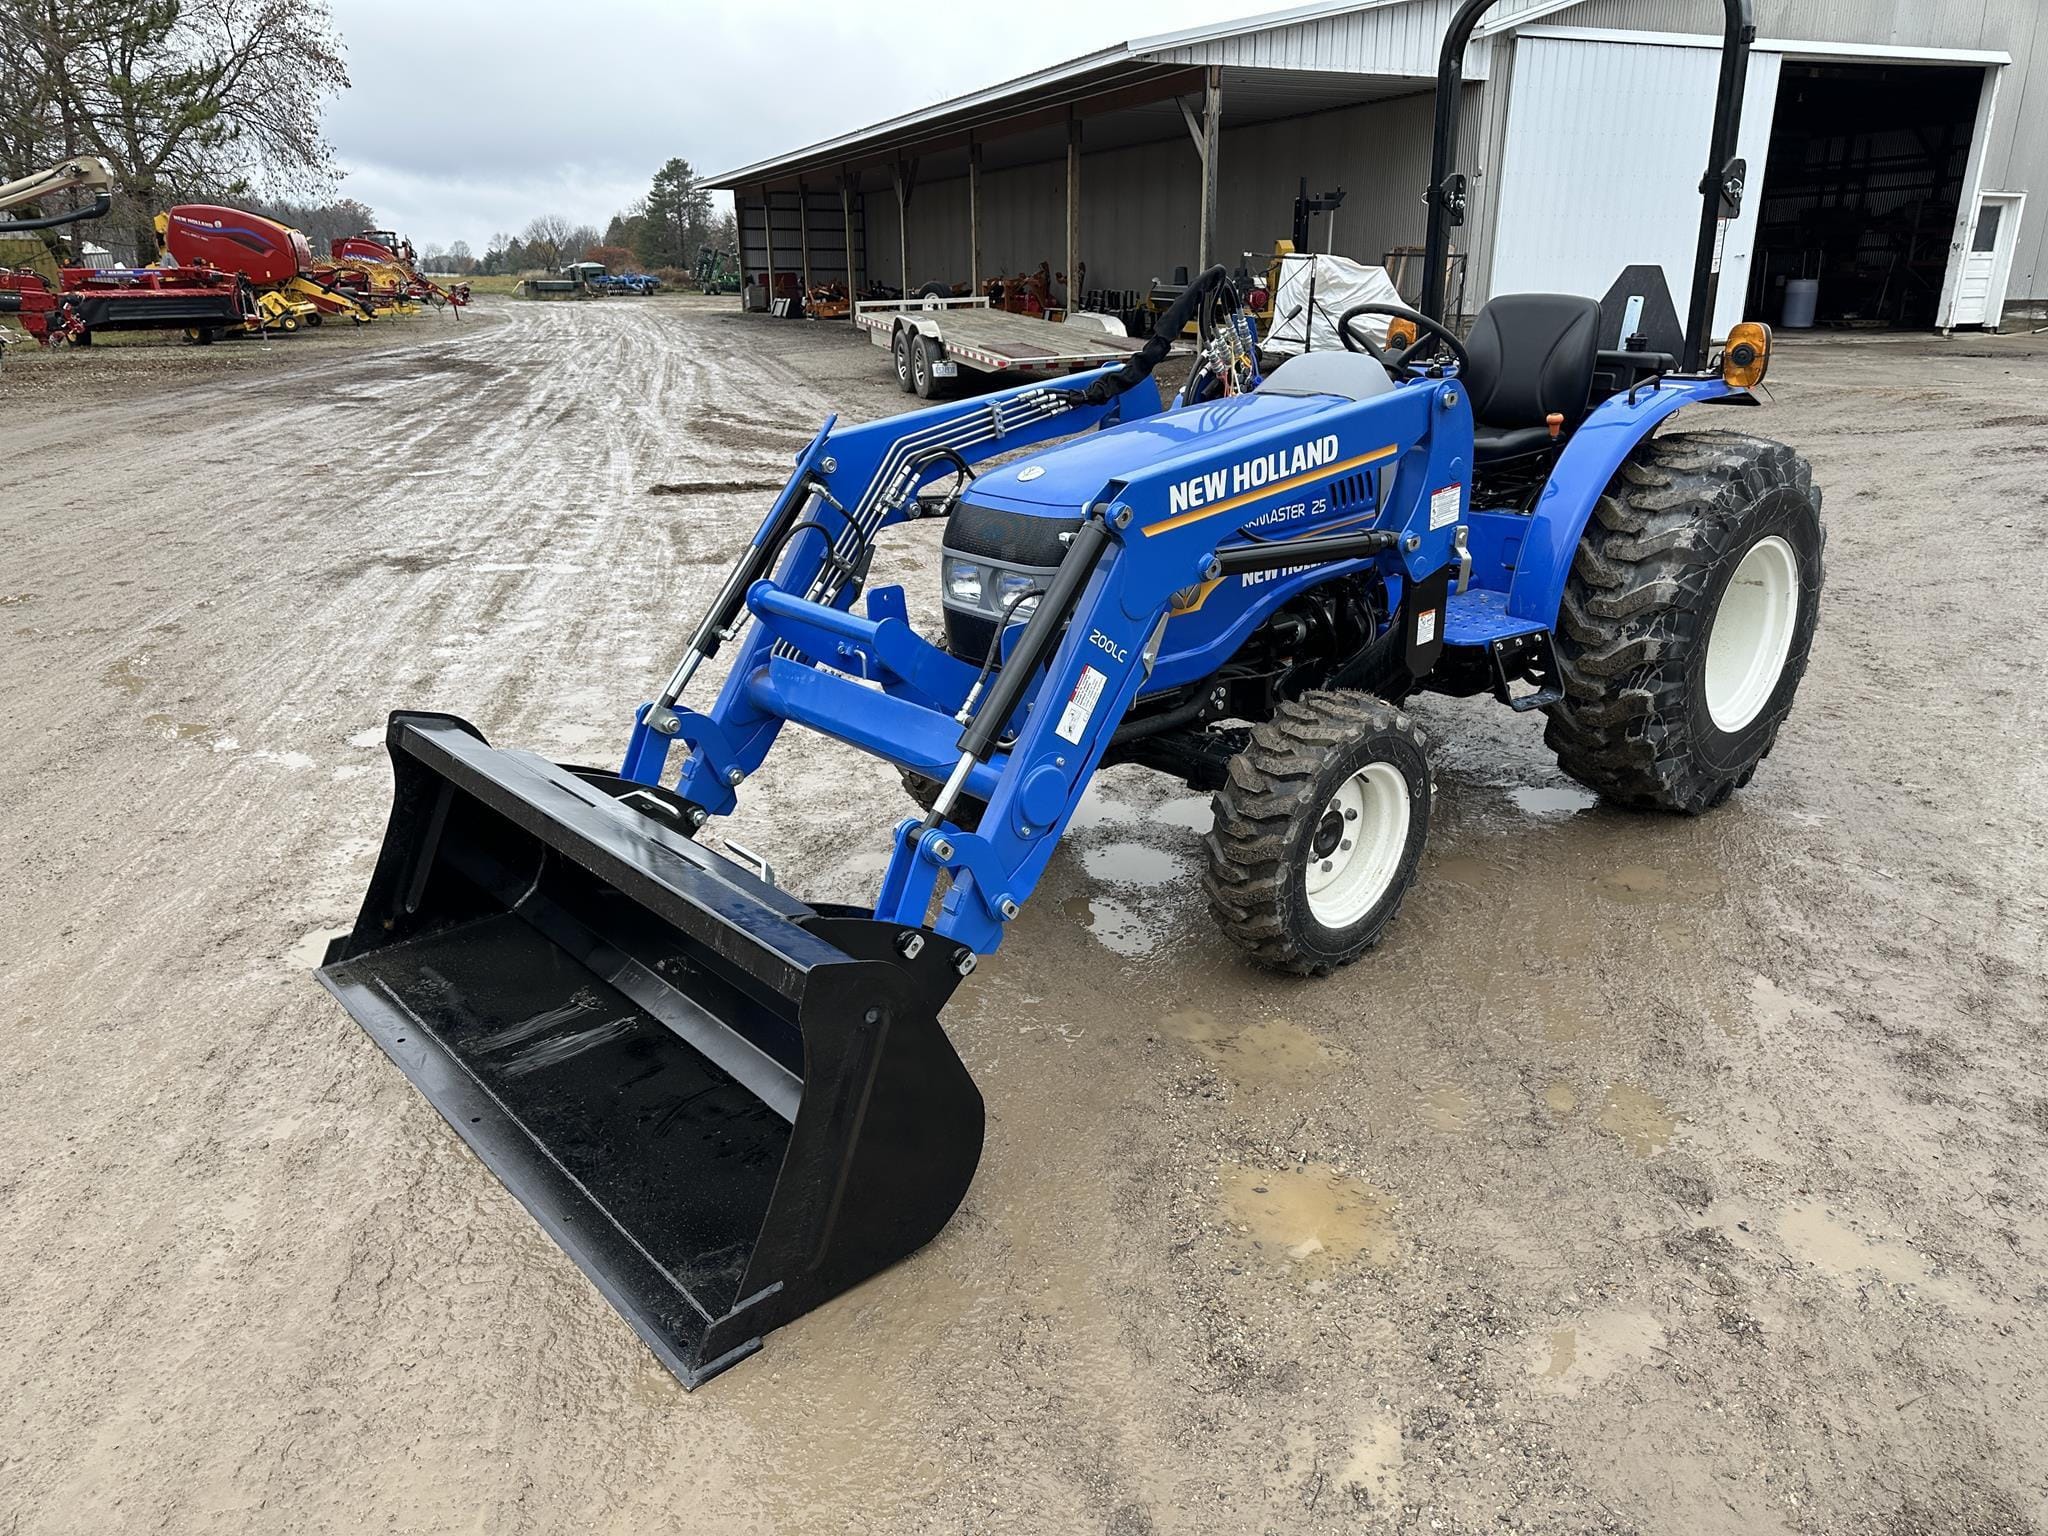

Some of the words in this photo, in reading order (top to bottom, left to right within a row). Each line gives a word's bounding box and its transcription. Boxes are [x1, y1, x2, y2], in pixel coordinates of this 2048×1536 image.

[1169, 469, 1228, 515] NEW
[1233, 434, 1339, 494] HOLLAND
[1242, 503, 1306, 529] MASTER
[1311, 498, 1327, 515] 25
[1242, 569, 1278, 588] NEW
[1088, 628, 1128, 663] 200LC
